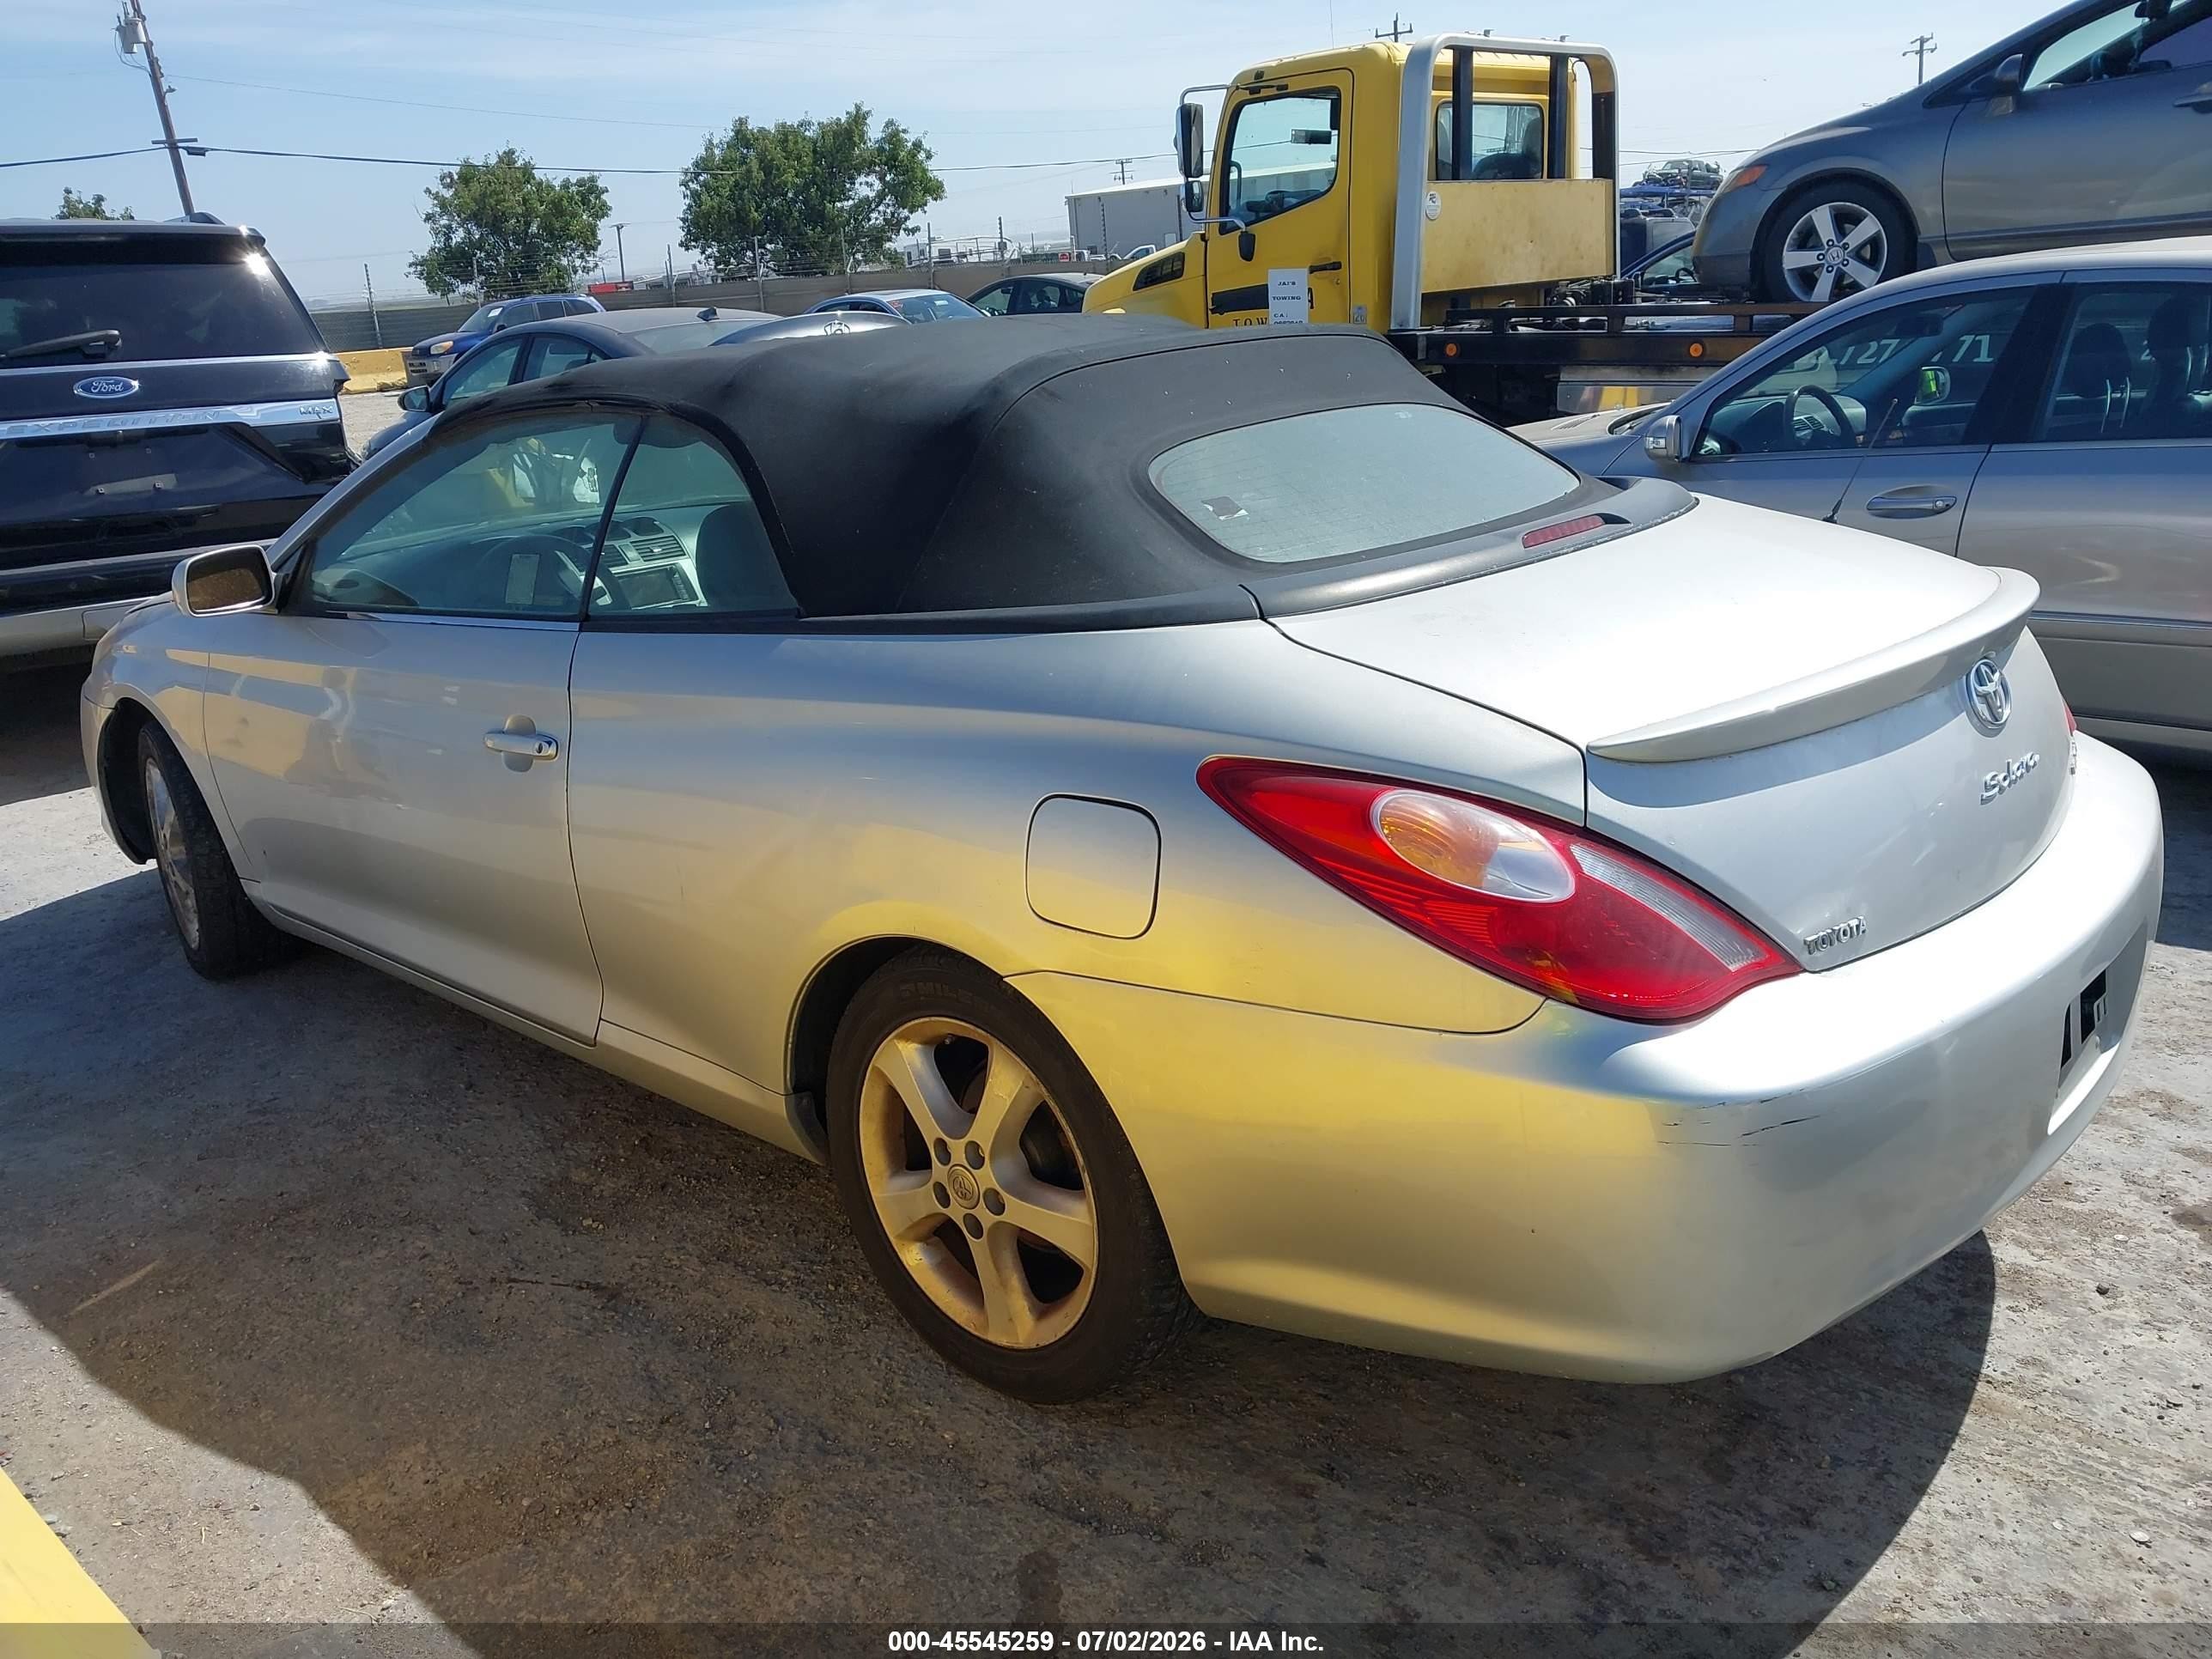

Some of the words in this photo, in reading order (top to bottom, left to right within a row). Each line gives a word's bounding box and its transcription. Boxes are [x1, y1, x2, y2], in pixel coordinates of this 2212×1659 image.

[91, 380, 125, 392] Ford
[299, 405, 333, 416] MAX
[1804, 915, 1867, 955] TOYOTA
